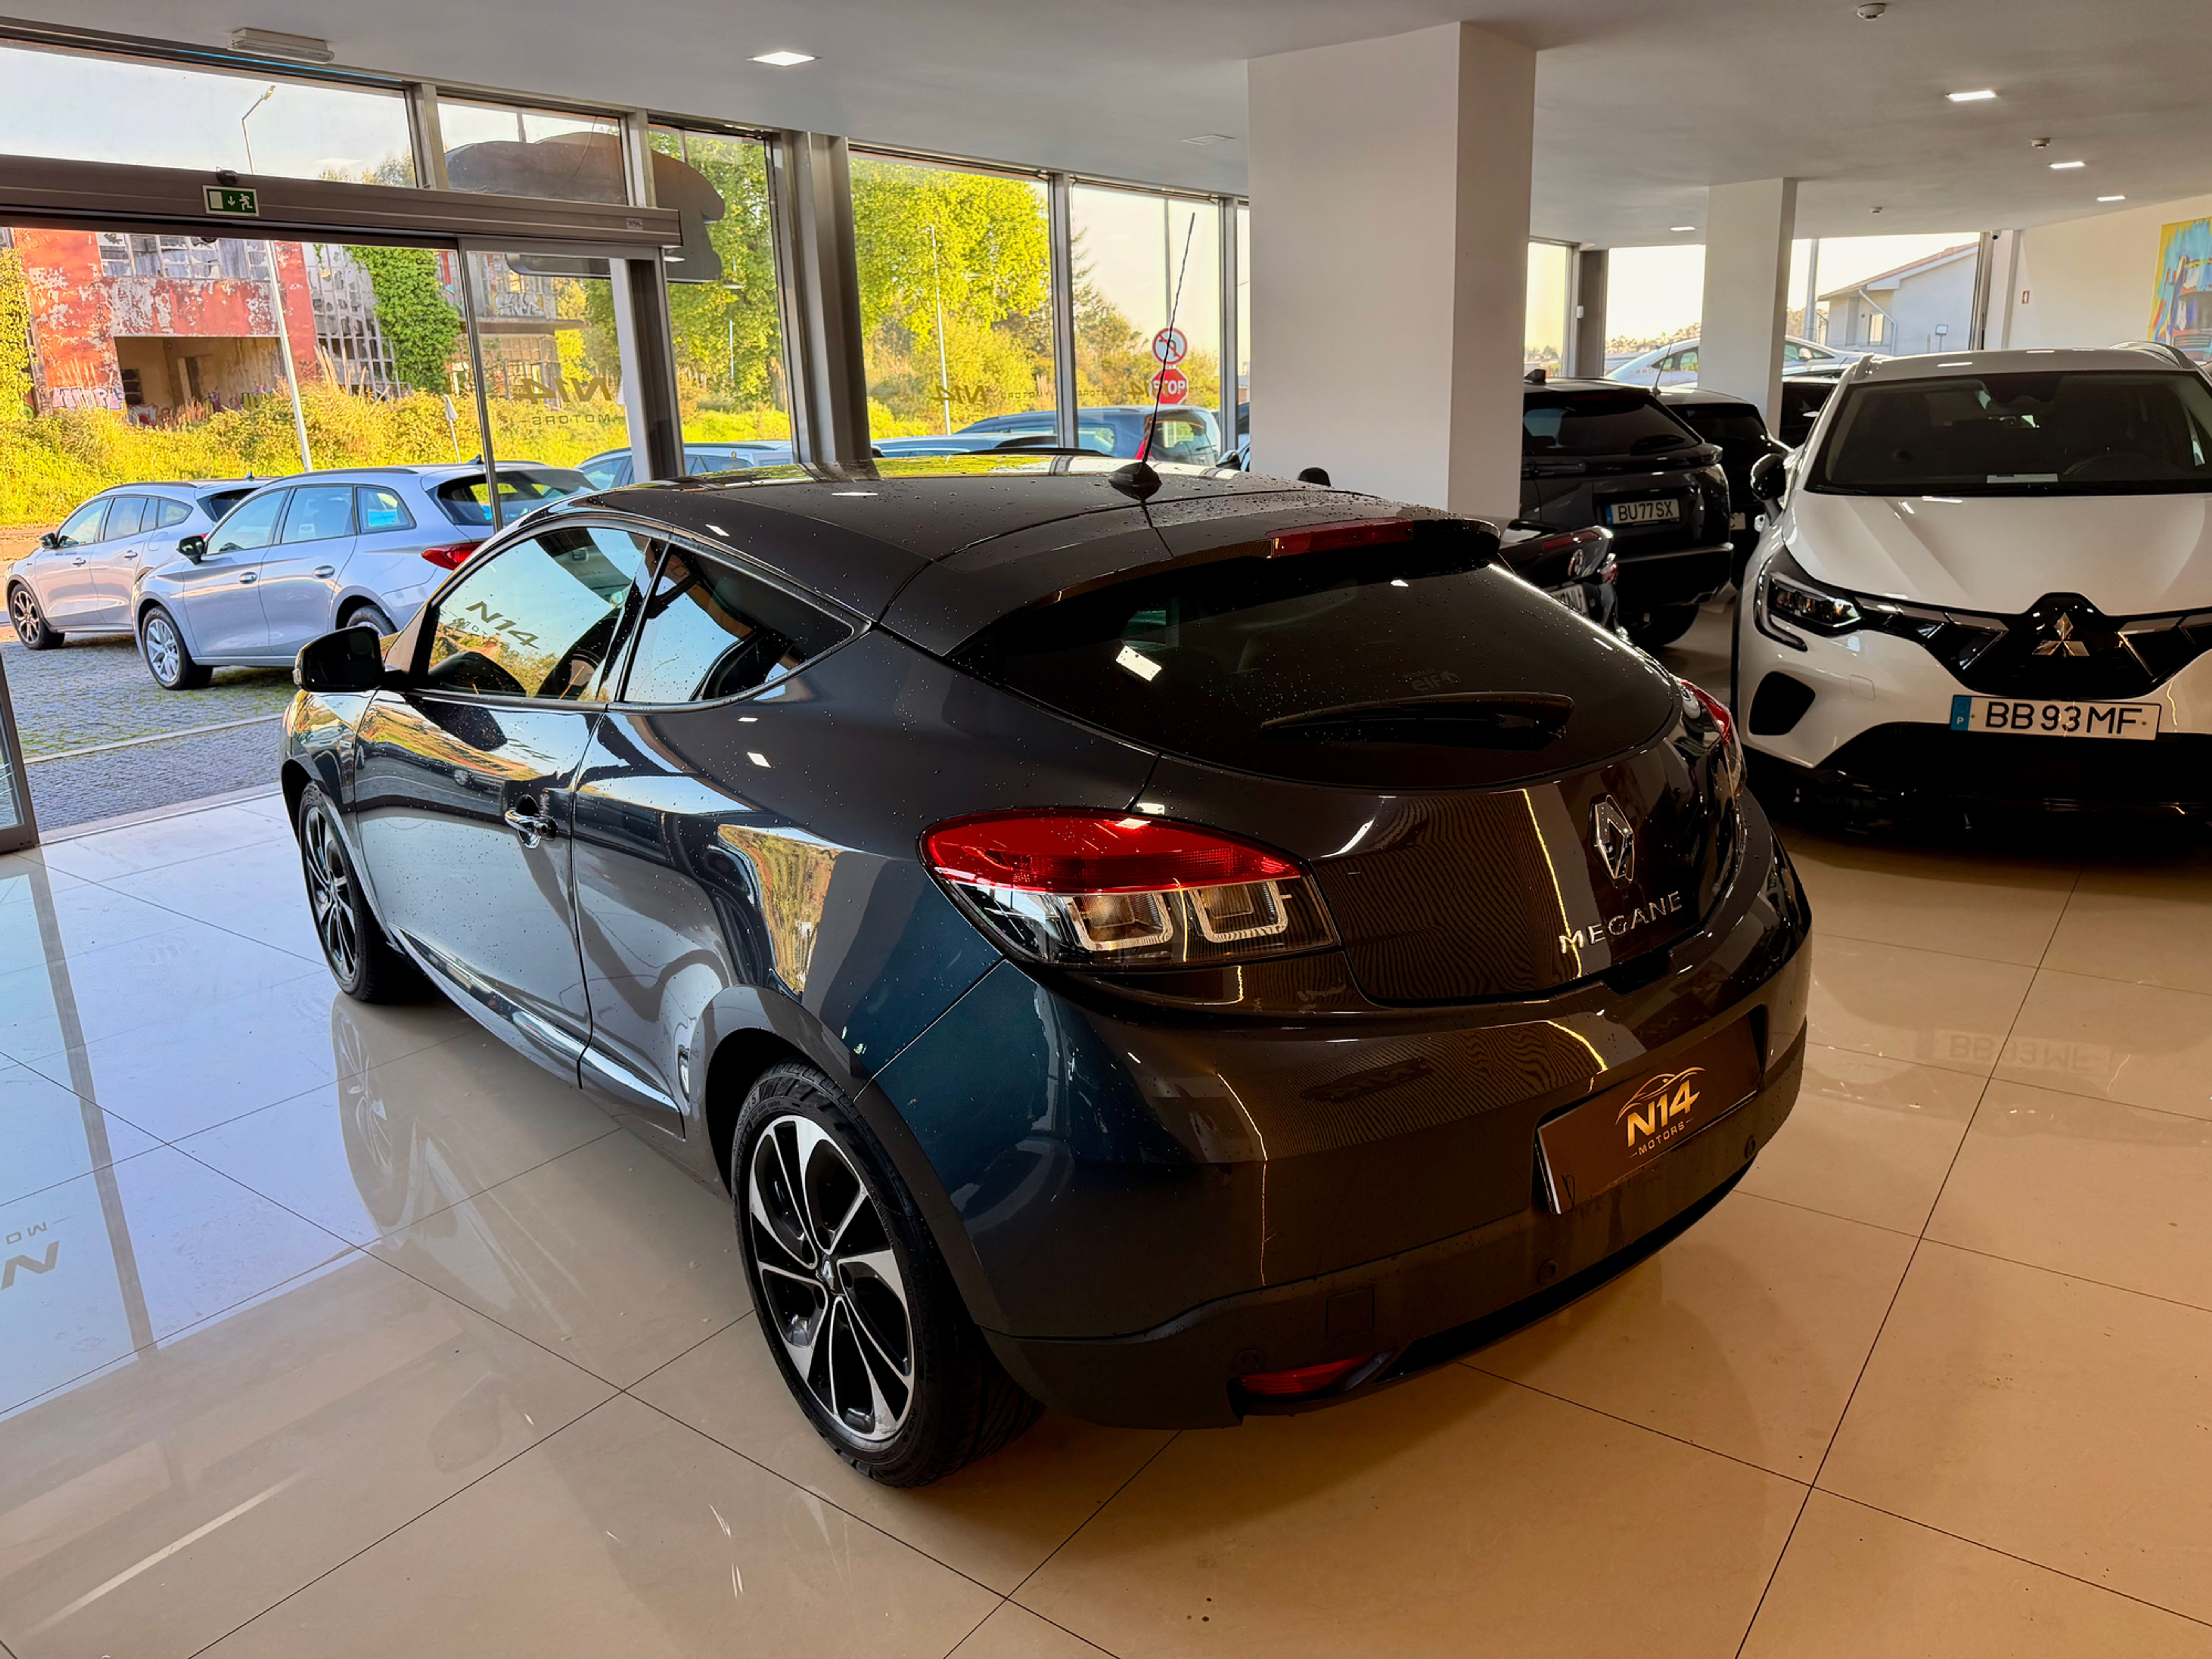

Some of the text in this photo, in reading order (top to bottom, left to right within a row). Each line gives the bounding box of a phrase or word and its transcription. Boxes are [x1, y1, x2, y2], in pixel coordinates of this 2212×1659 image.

[466, 601, 540, 650] N14
[1957, 716, 1964, 725] P
[1559, 891, 1683, 954] MEGANE
[1628, 1080, 1700, 1147] N14
[1638, 1121, 1685, 1151] MOTORS
